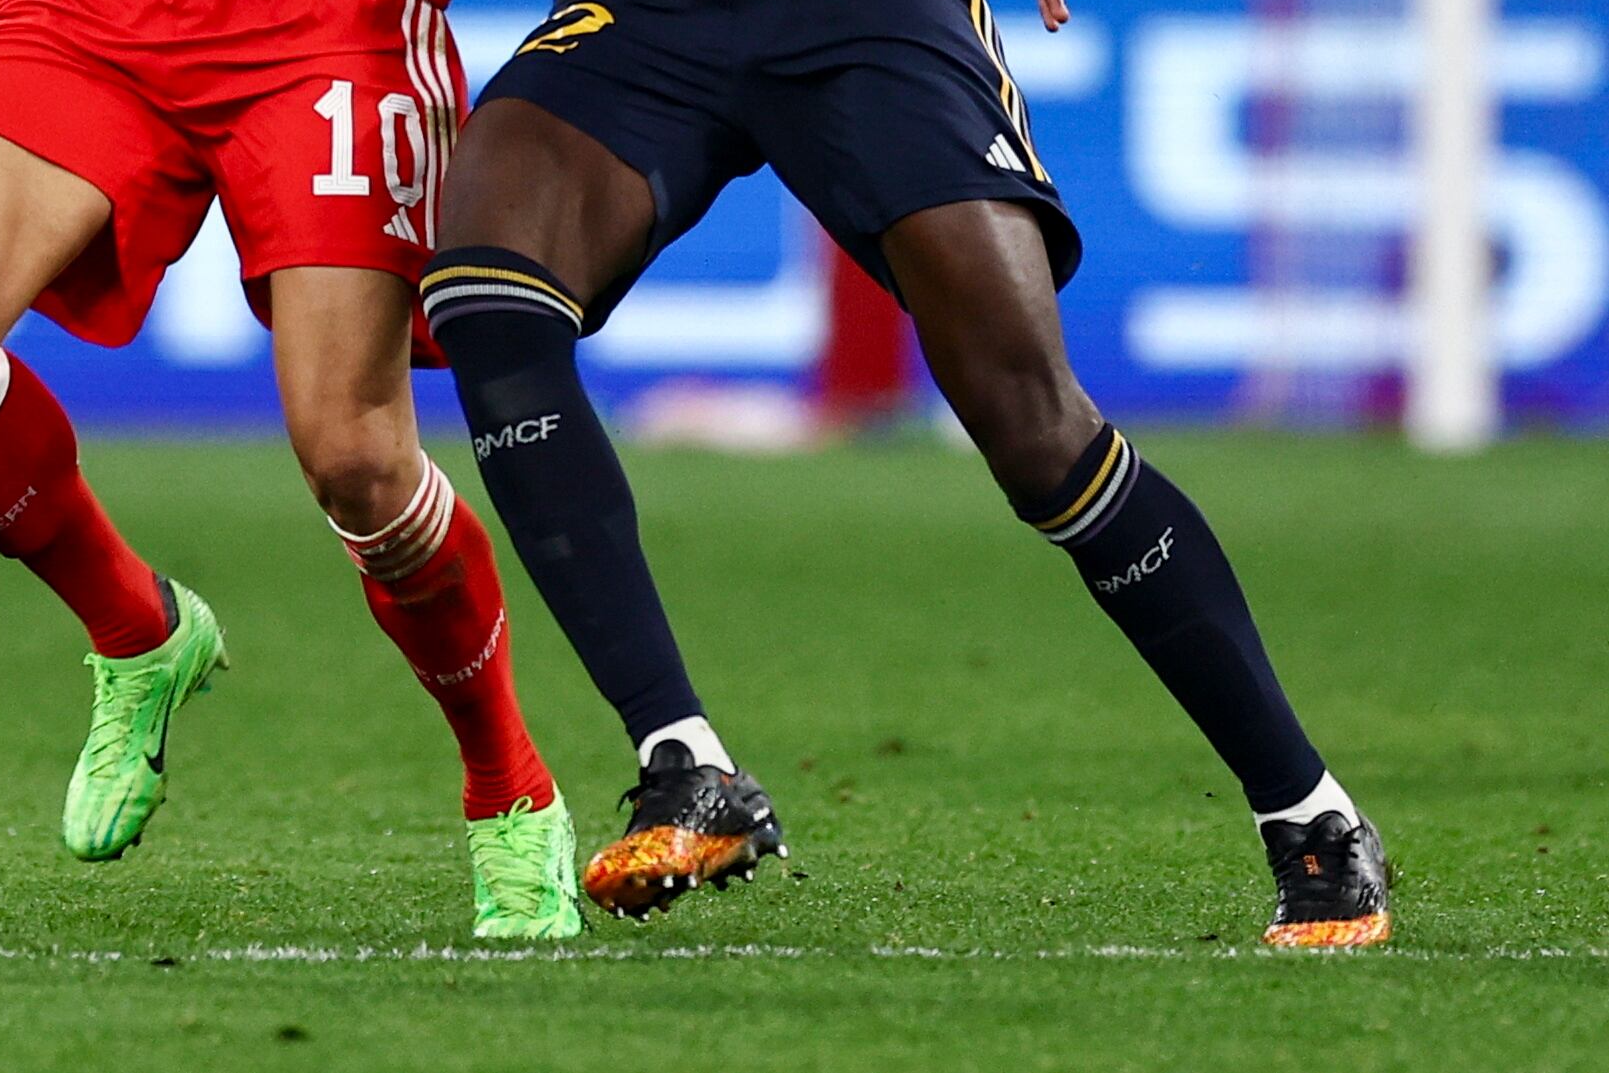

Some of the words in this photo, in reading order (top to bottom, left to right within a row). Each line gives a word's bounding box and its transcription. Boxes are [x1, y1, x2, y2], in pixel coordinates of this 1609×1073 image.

[312, 80, 426, 207] 10
[474, 413, 561, 462] RMCF
[1095, 526, 1174, 594] RMCF
